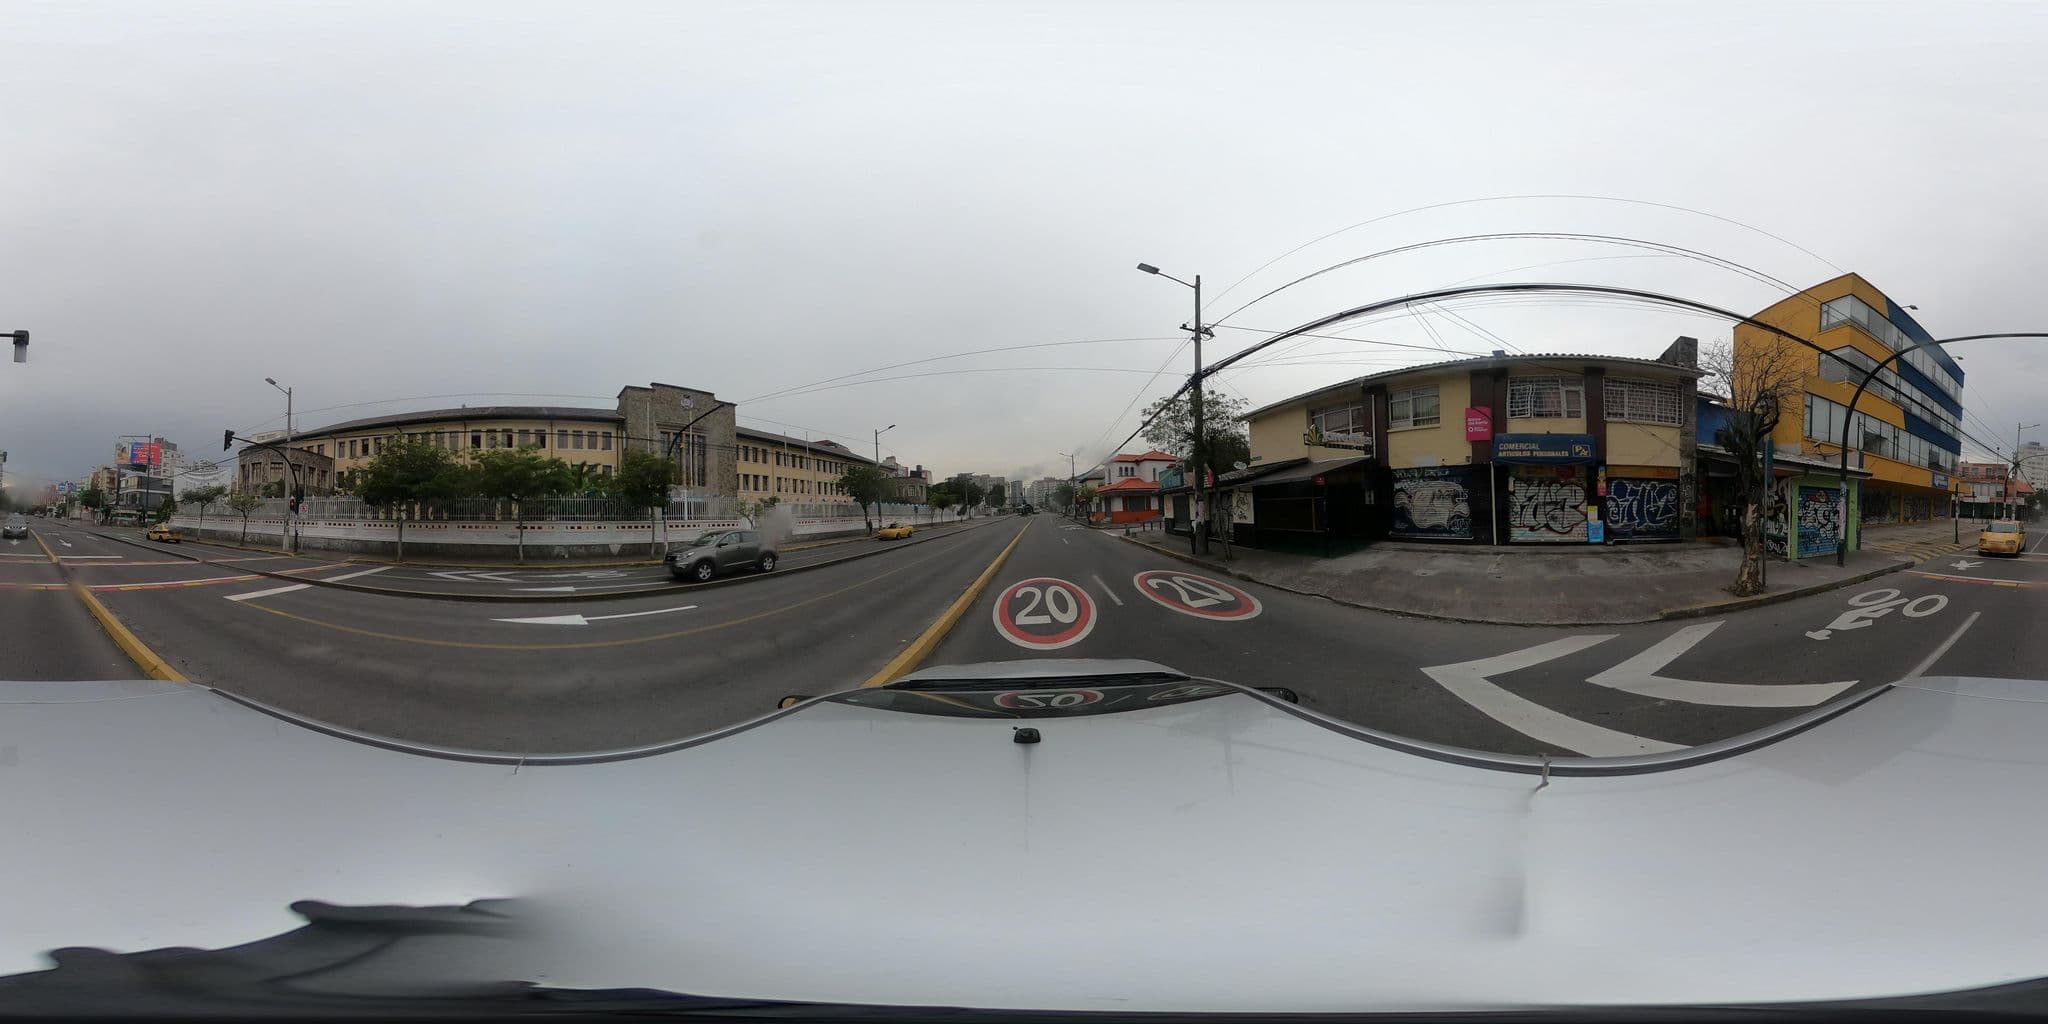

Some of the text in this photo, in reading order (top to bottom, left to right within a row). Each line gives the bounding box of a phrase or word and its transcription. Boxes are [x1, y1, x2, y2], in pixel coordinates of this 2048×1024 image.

[1499, 443, 1540, 451] COMERCIAL
[1015, 585, 1078, 625] 20
[1147, 576, 1235, 608] 20
